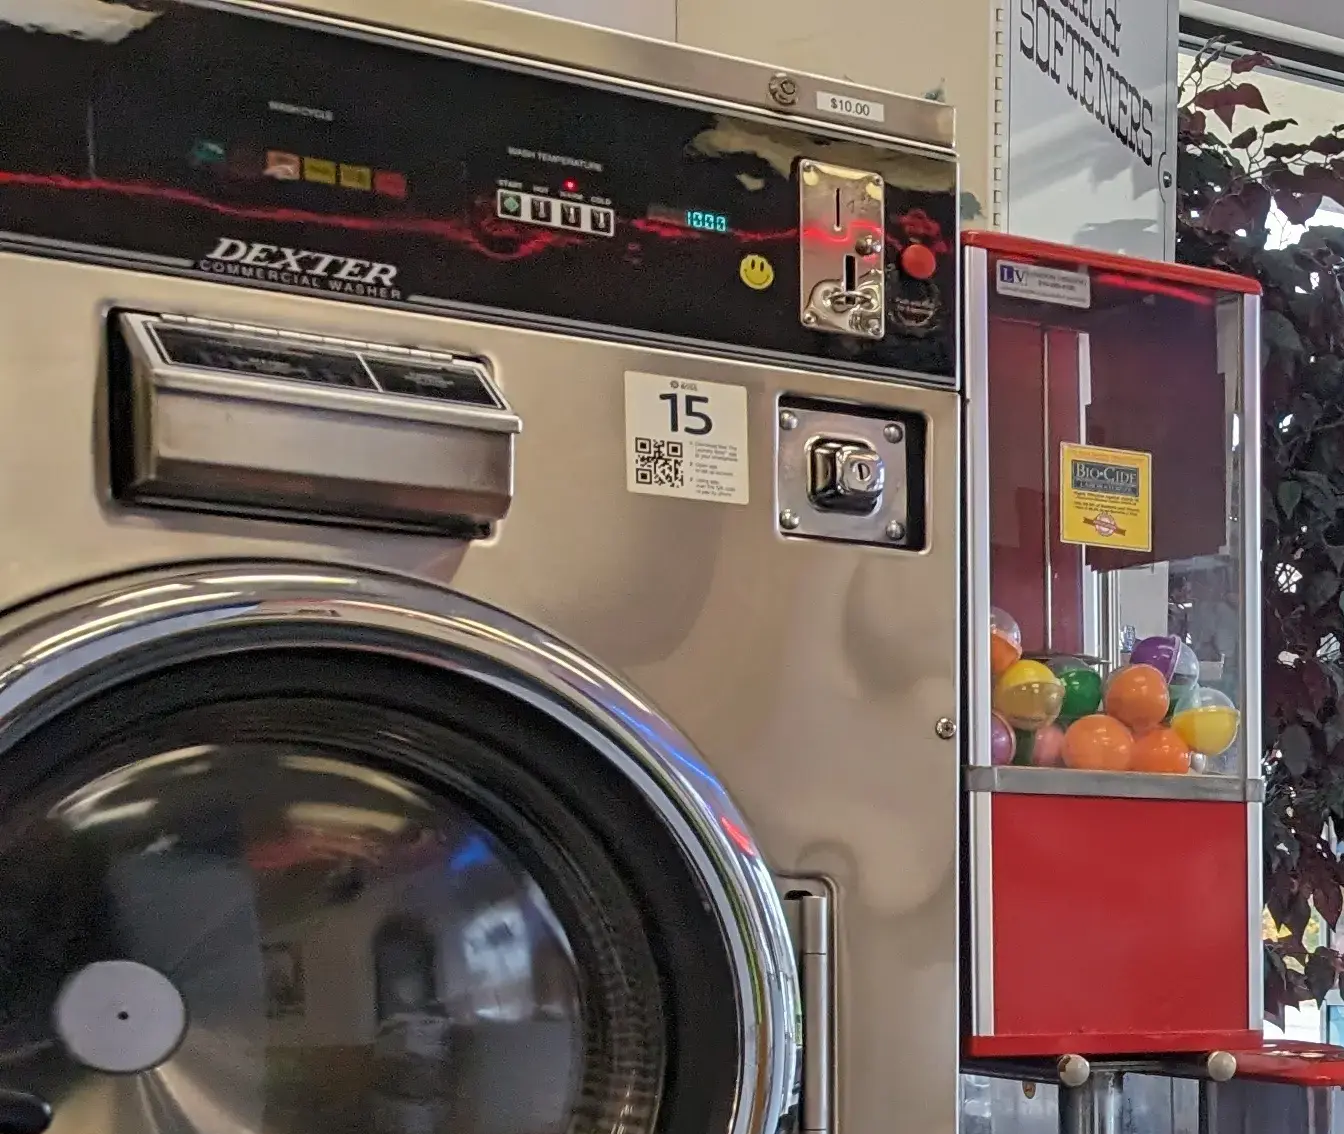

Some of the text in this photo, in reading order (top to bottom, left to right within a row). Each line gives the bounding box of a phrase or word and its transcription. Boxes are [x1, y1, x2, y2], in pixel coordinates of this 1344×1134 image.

[1020, 0, 1153, 167] SOFTENERS
[830, 98, 871, 117] $10.00
[200, 259, 402, 301] COMMERCIAL WASHER
[206, 237, 399, 287] DEXTER
[659, 393, 713, 436] 15
